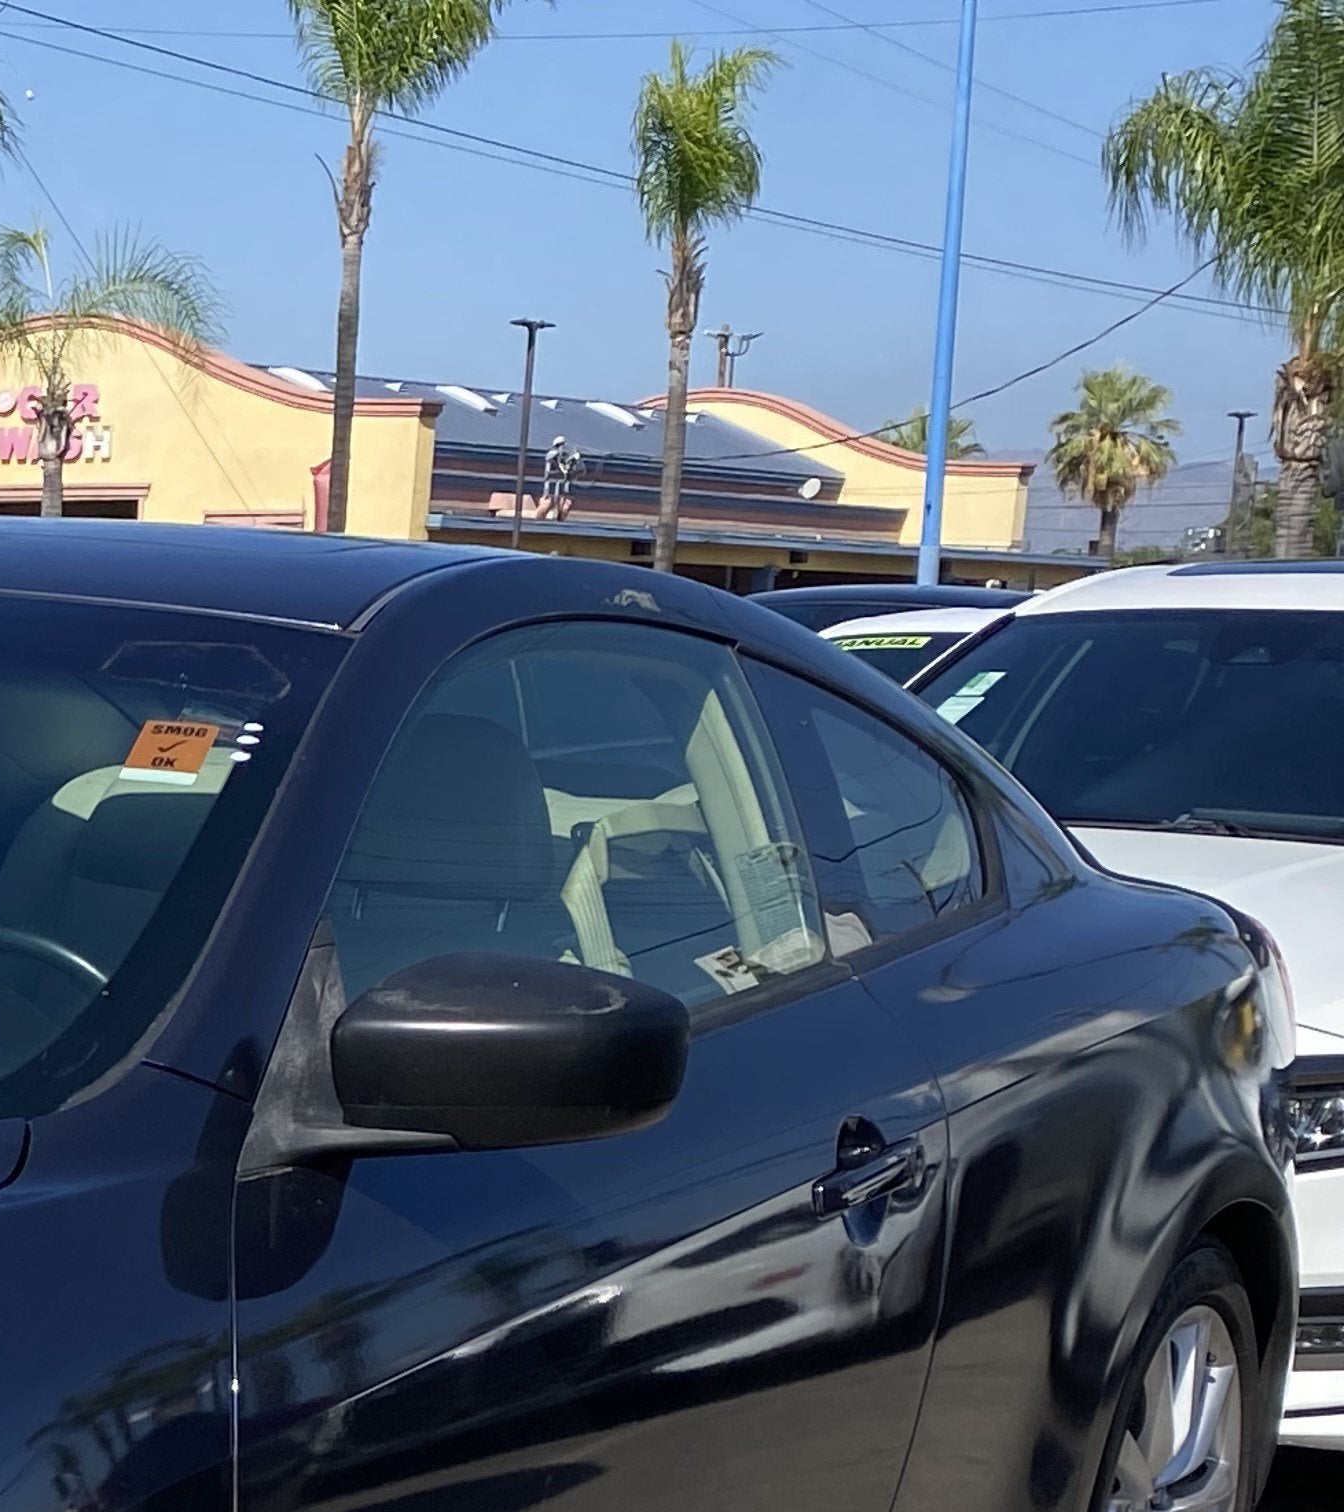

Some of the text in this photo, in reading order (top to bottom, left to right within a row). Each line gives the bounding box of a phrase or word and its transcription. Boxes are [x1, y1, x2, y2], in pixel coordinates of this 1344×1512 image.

[17, 384, 101, 424] CR
[150, 724, 209, 738] SMOG
[150, 756, 178, 768] OK
